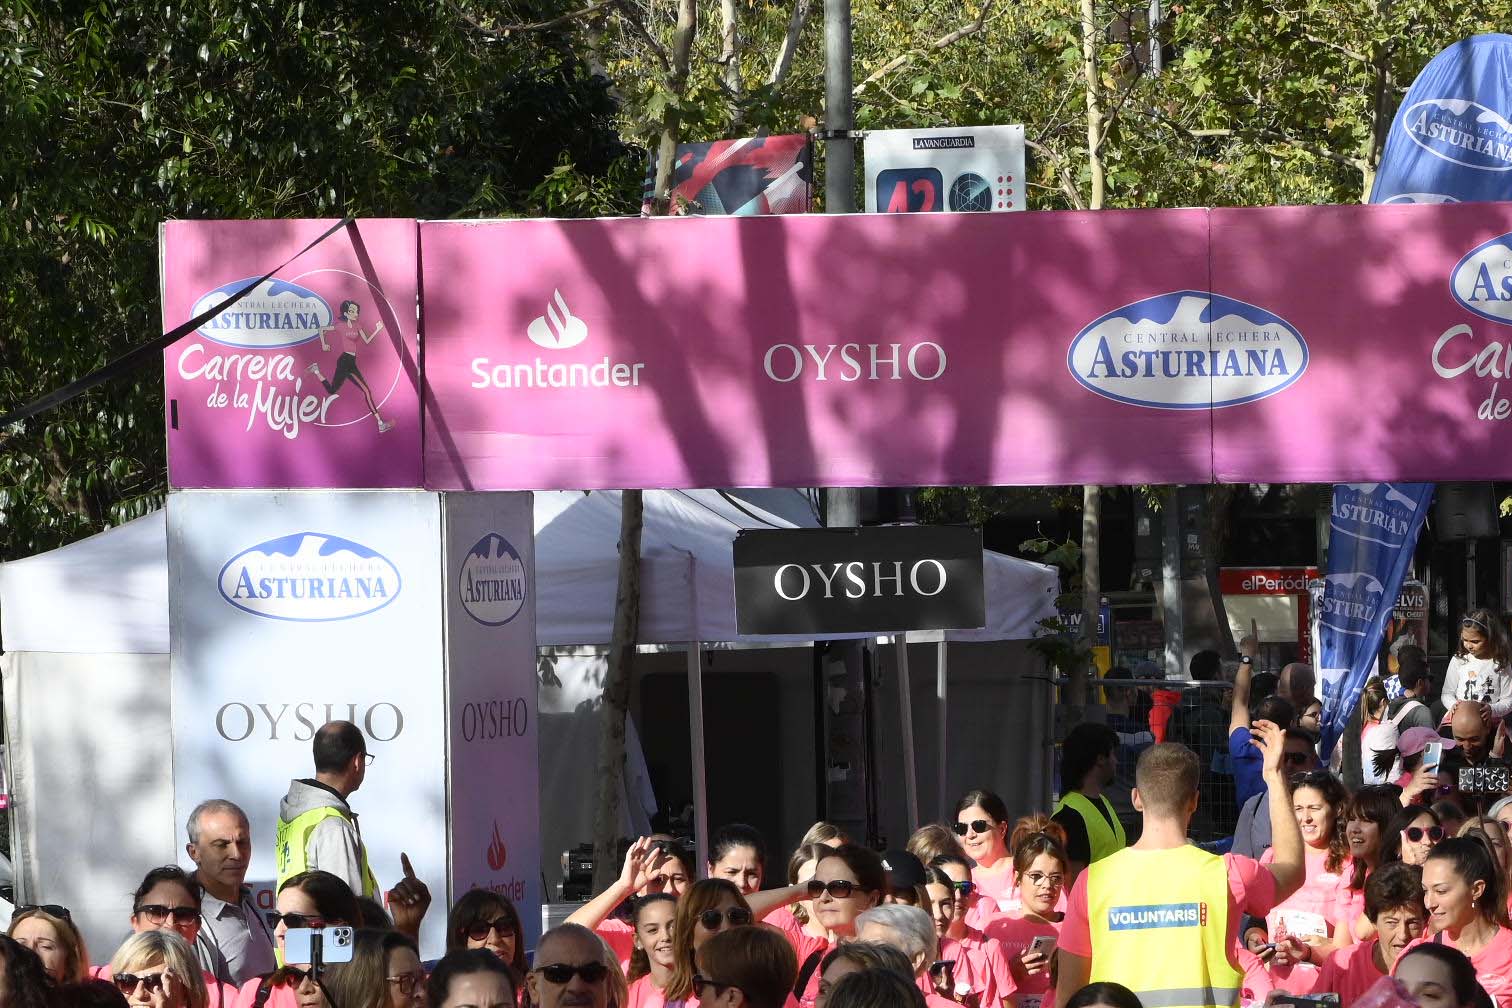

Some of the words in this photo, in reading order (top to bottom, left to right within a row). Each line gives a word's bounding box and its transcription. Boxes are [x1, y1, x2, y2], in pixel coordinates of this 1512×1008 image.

[202, 303, 321, 330] ASTURIANA
[1124, 331, 1198, 344] CENTRAL
[178, 344, 295, 380] Carrera
[471, 356, 645, 388] Santander
[764, 341, 947, 383] OYSHO
[1087, 333, 1290, 378] ASTURIANA
[207, 384, 228, 408] de
[233, 382, 249, 408] la
[246, 377, 340, 440] Mujer
[1478, 387, 1512, 421] de
[233, 566, 388, 599] ASTURIANA
[465, 568, 522, 602] ASTURIANA
[774, 558, 947, 601] OYSHO
[461, 698, 528, 742] OYSHO
[1110, 908, 1198, 926] VOLUNTARIS
